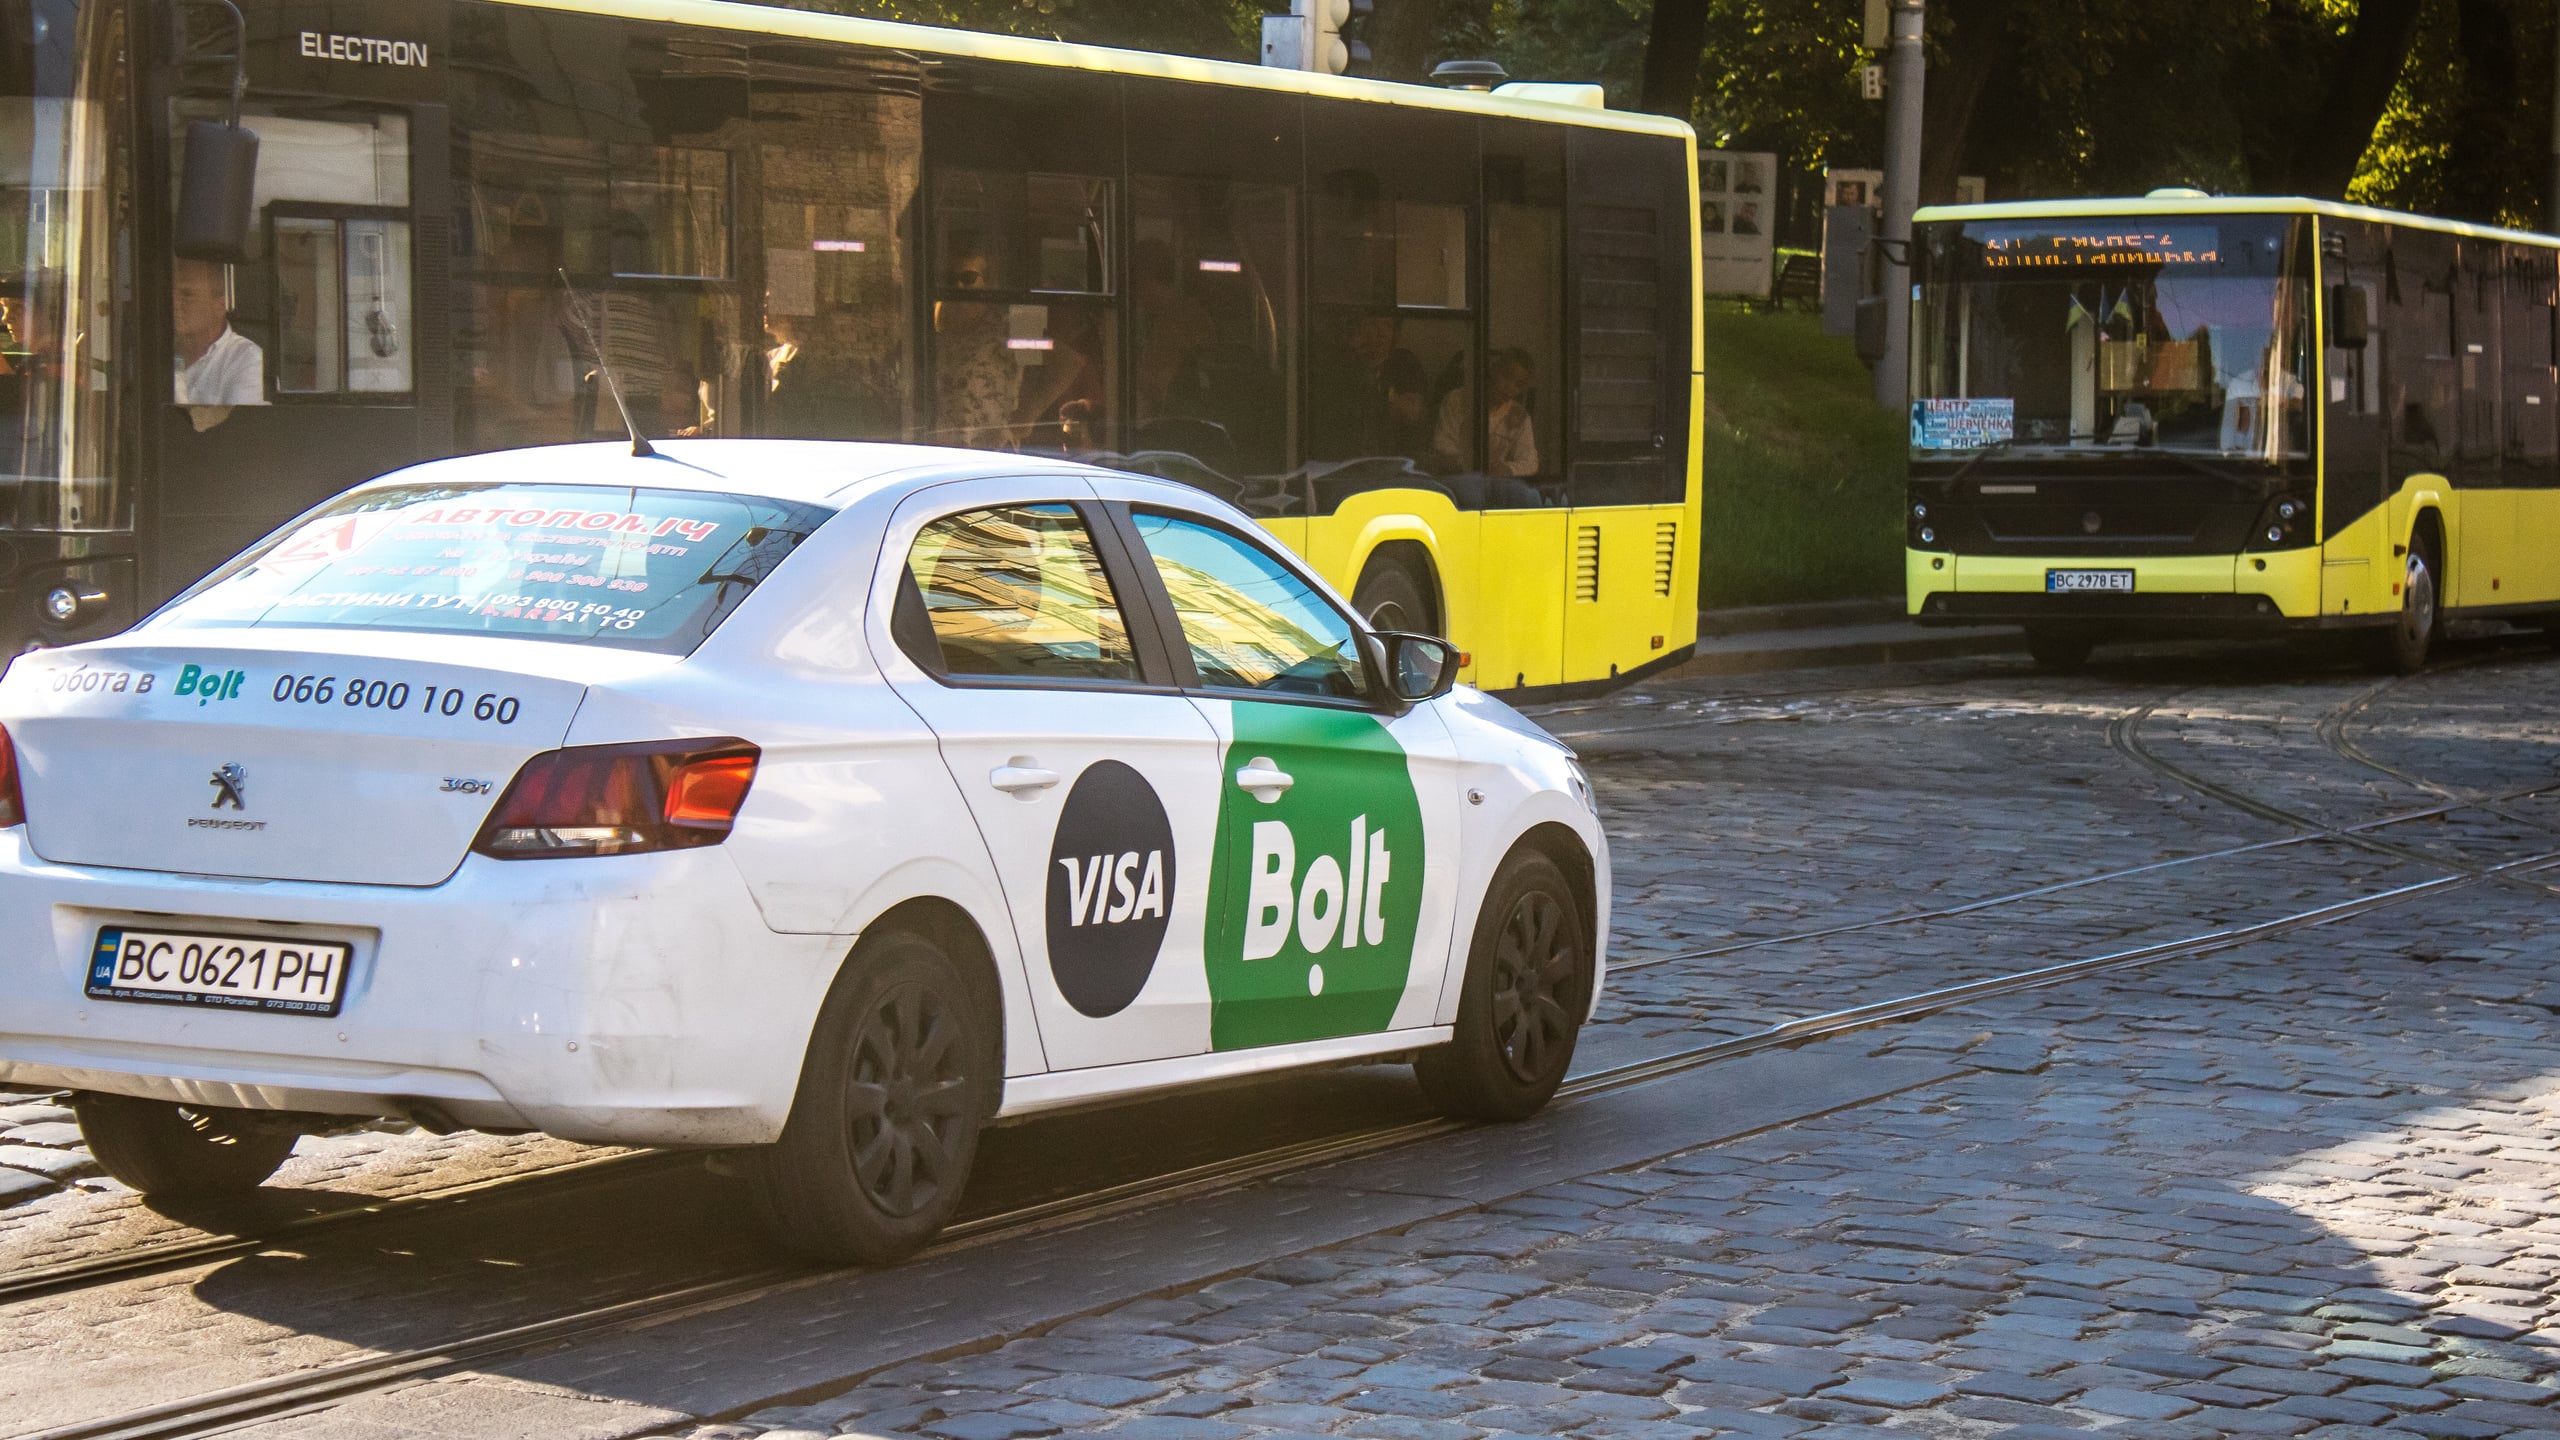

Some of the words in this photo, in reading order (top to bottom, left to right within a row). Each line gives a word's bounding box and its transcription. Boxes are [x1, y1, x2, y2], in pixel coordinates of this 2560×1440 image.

[300, 31, 428, 67] ELECTRON
[1926, 401, 1970, 413] ЦЕНТР
[1948, 419, 2012, 431] ШЕВЧЕНКА
[2056, 574, 2074, 588] BC
[2078, 574, 2107, 588] 2978
[2110, 574, 2129, 588] ET
[489, 594, 535, 608] 093
[534, 598, 580, 611] 800
[579, 602, 613, 616] 50
[612, 607, 647, 621] 40
[38, 664, 130, 693] обота
[174, 664, 246, 707] Bolt
[272, 674, 337, 704] 066
[342, 678, 411, 711] 800
[422, 685, 465, 717] 10
[472, 693, 521, 725] 60
[439, 776, 494, 796] 301
[187, 817, 268, 832] PEUGEOT
[1058, 849, 1165, 928] VISA
[1243, 813, 1392, 997] Bolt
[95, 966, 111, 979] UA
[118, 939, 174, 983] BC
[179, 943, 267, 990] 0621
[273, 949, 333, 995] PH
